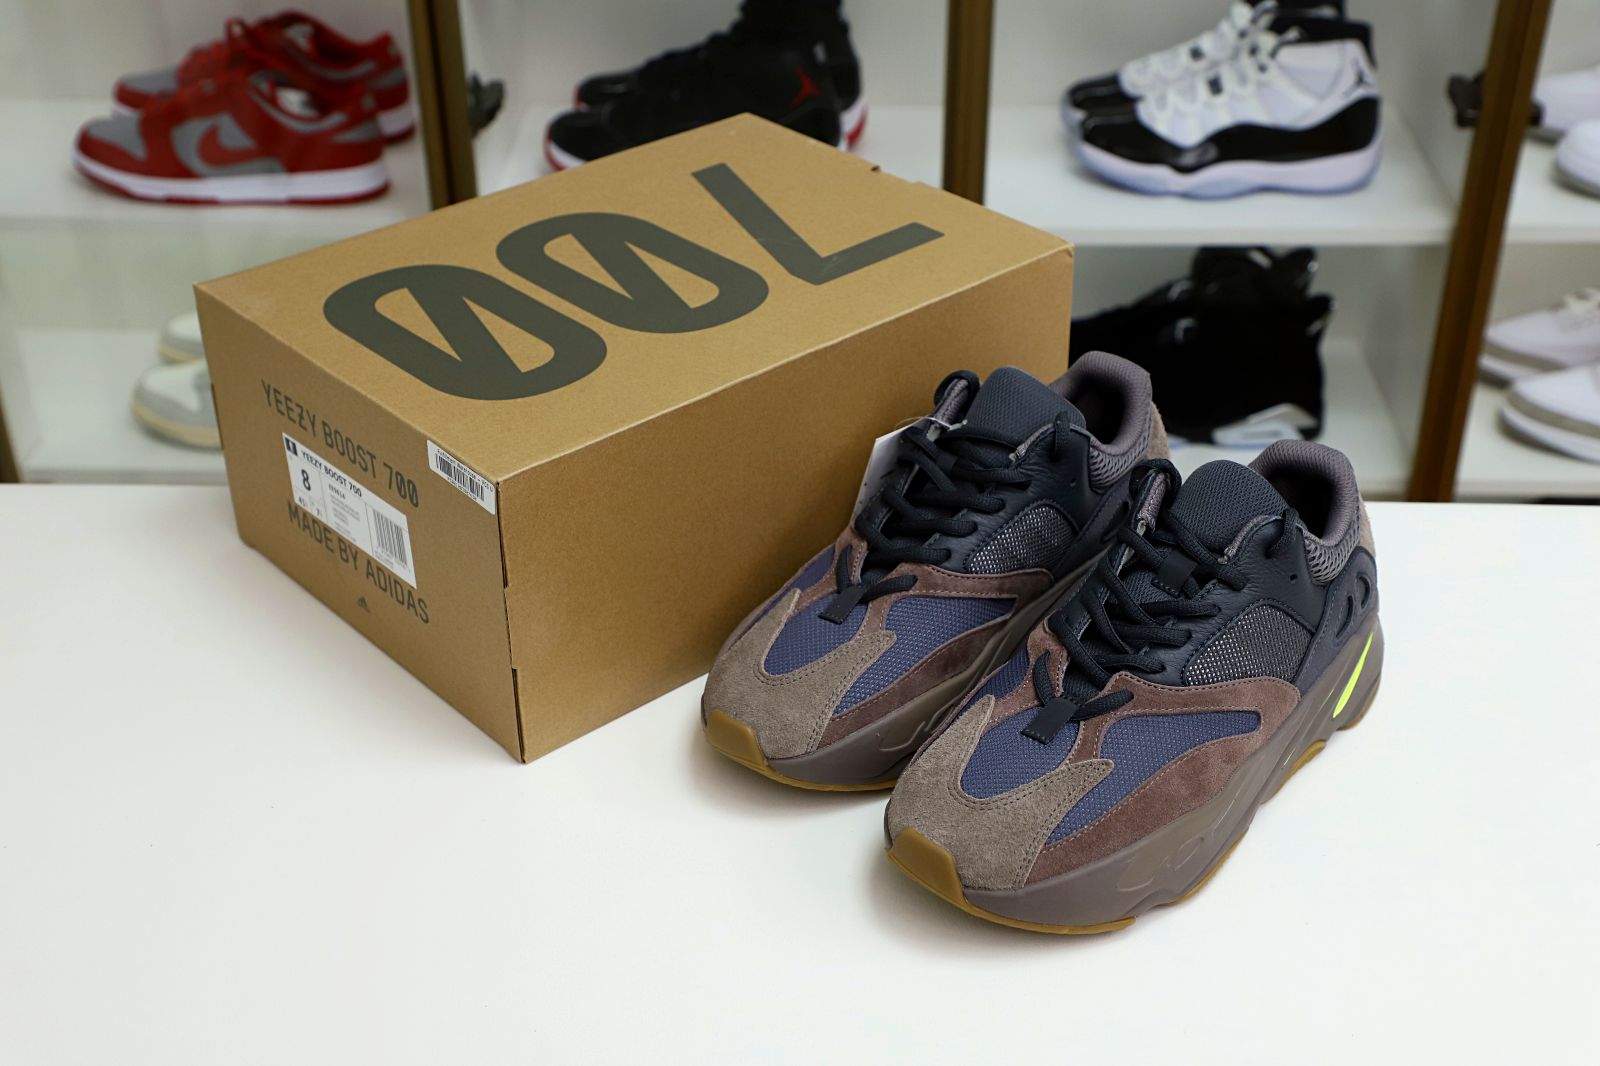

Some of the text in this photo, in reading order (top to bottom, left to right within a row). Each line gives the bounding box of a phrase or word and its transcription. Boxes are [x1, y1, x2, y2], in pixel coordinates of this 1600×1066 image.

[323, 162, 945, 400] 700
[261, 379, 316, 437] YEEZY
[322, 420, 377, 479] BOOST
[384, 462, 419, 508] 700
[301, 449, 362, 497] YEEZY BOOST 700
[301, 468, 312, 491] 8
[287, 500, 334, 553] MADE
[340, 541, 358, 571] BY
[366, 562, 430, 624] ADIDAS
